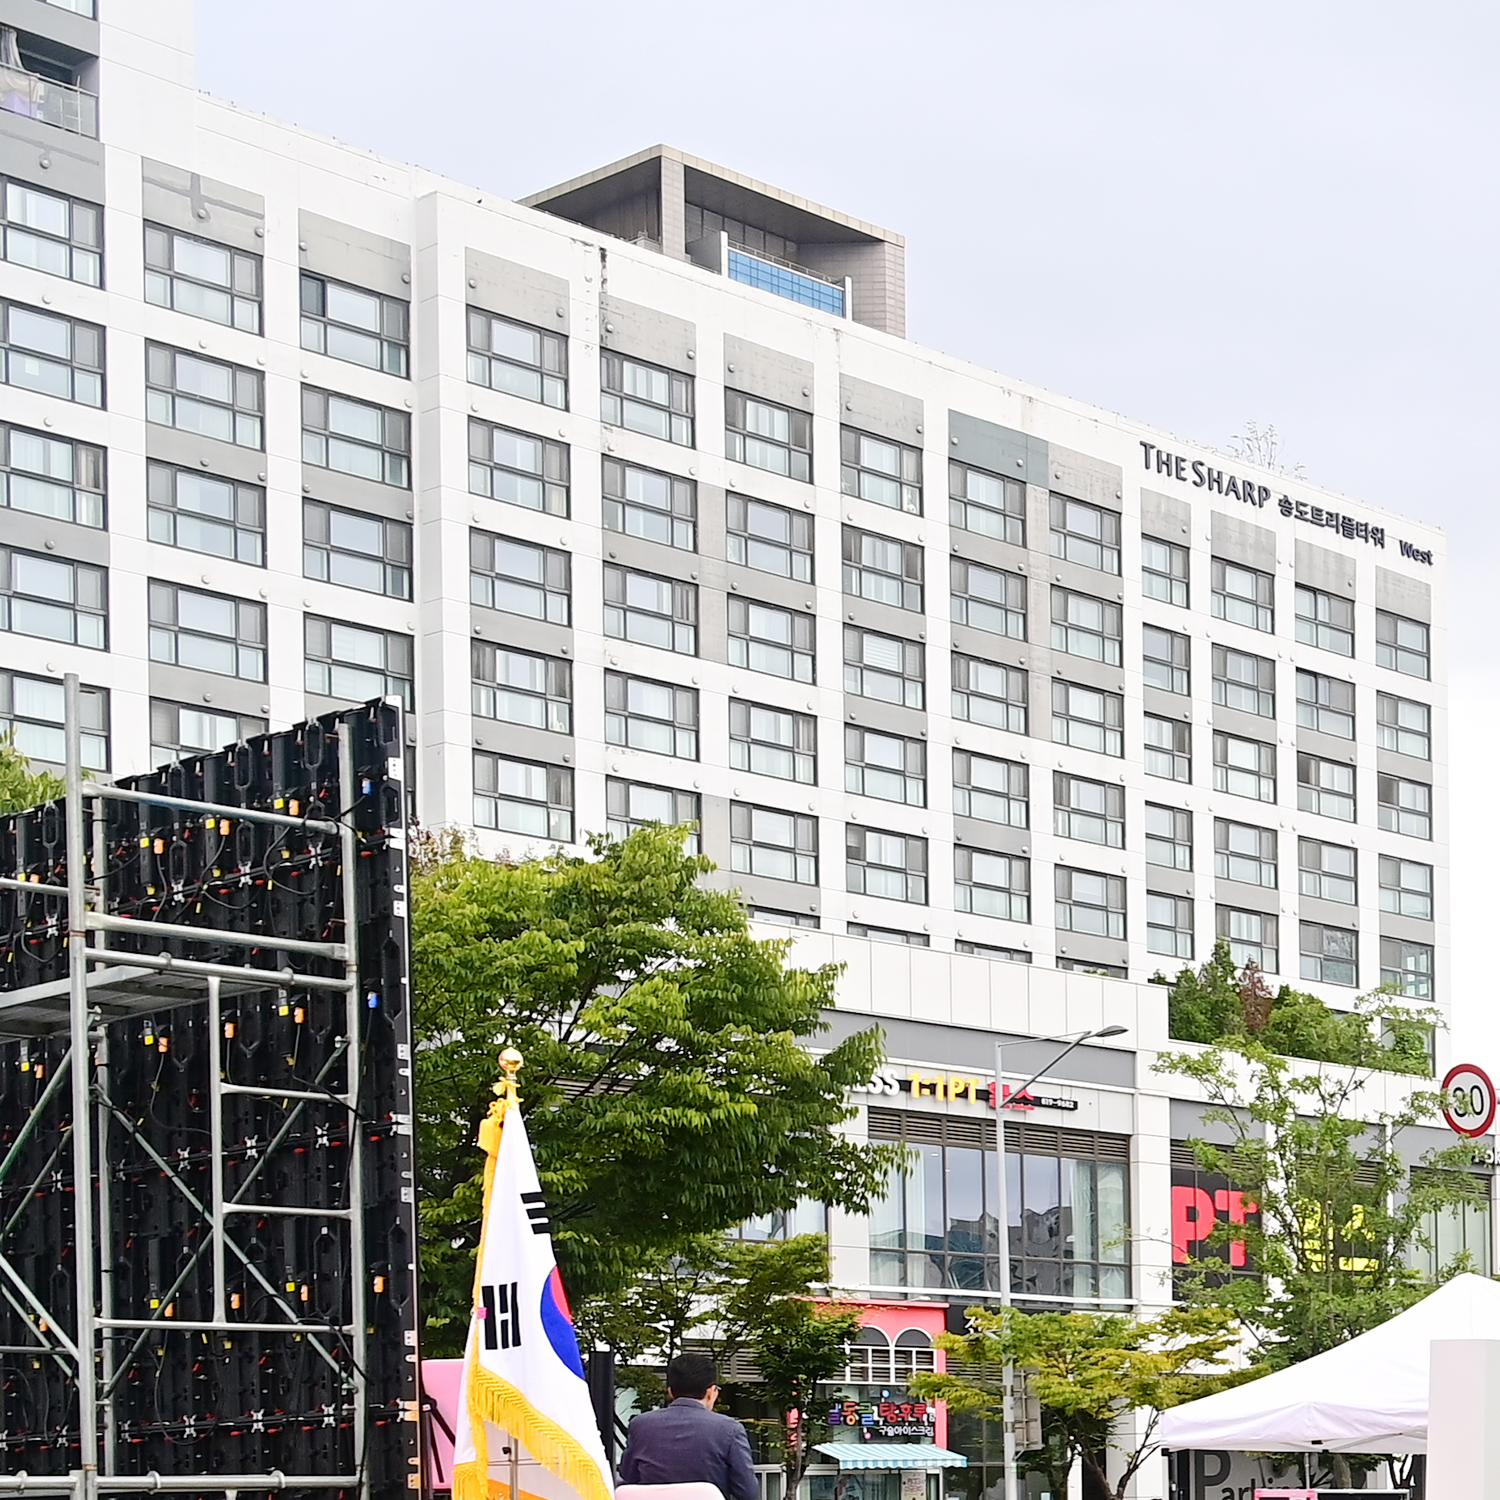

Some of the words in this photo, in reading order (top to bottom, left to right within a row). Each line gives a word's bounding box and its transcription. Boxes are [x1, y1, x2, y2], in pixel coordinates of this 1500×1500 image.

[1139, 440, 1188, 481] THE
[1192, 460, 1272, 509] SHARP
[1278, 494, 1386, 549] 송도트리플타워
[1399, 540, 1434, 566] West
[1453, 1084, 1485, 1118] 30
[1171, 1186, 1259, 1267] PT
[879, 1401, 928, 1424] 탕후루
